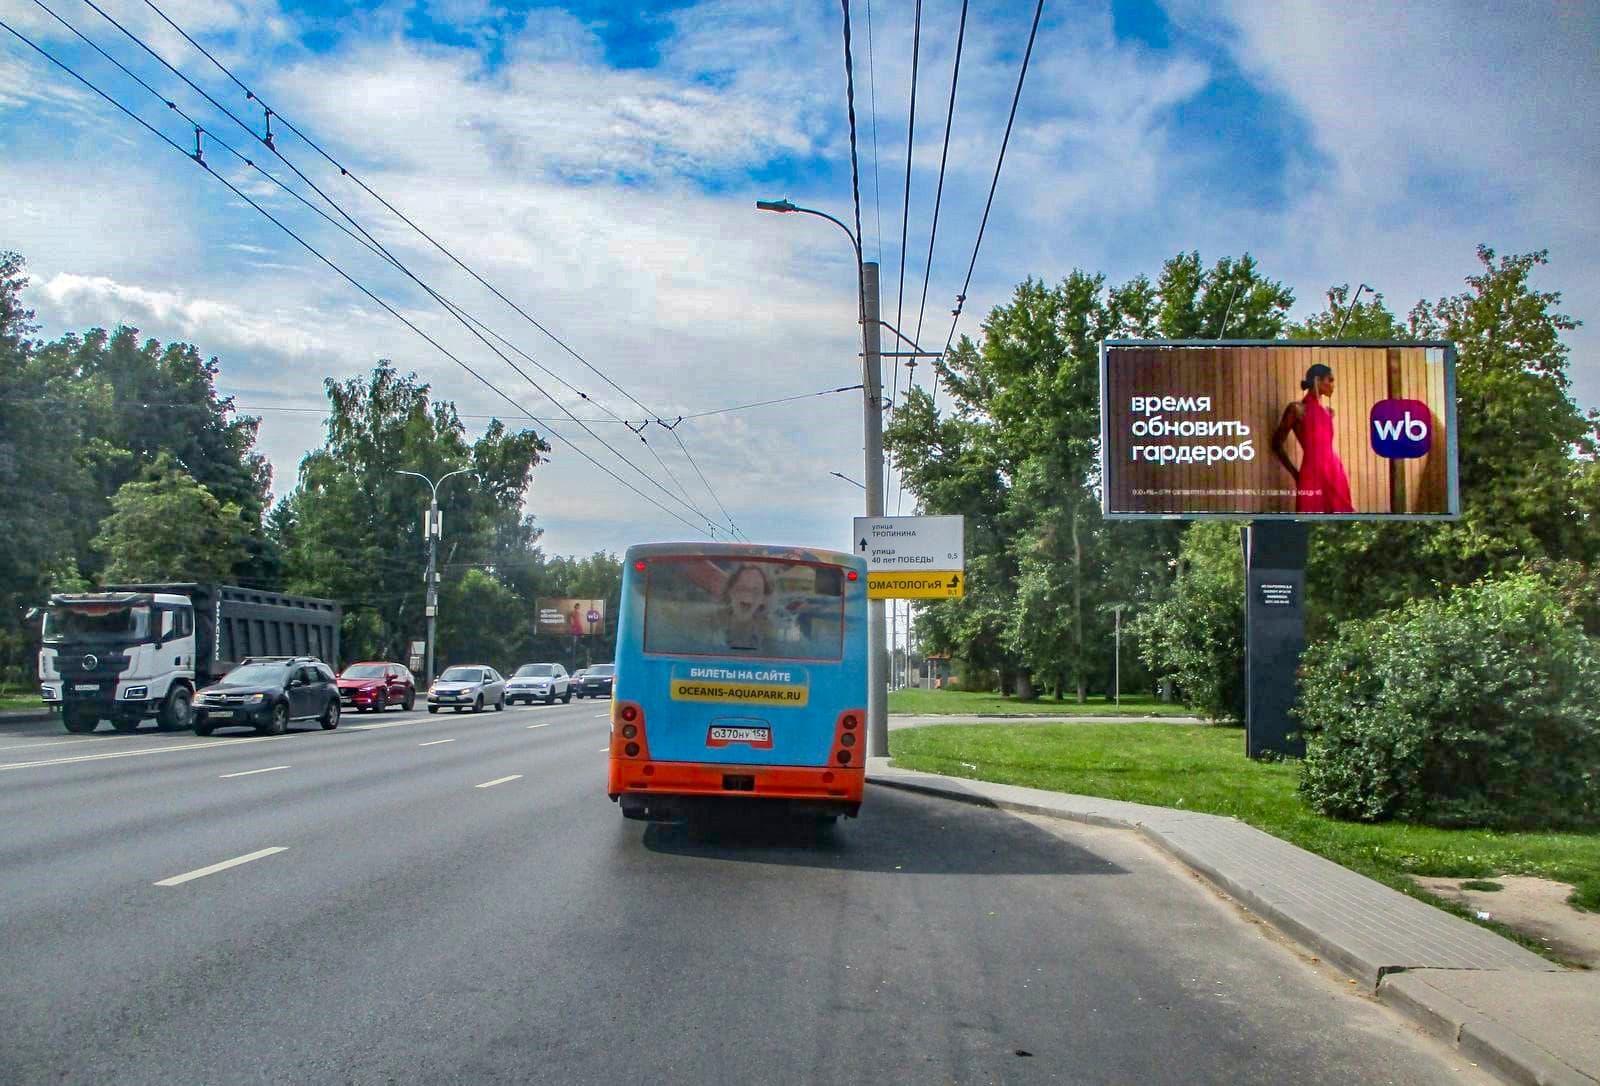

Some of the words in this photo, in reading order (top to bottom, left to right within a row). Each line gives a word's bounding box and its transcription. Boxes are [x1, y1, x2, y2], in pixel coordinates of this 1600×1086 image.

[1131, 396, 1211, 417] время
[1131, 415, 1250, 437] обновить
[1373, 411, 1428, 442] wb
[1132, 439, 1255, 466] гардероб
[872, 530, 917, 538] ТРОПИНИНА
[871, 556, 881, 564] 40
[897, 556, 934, 565] ПОБЕДЫ
[690, 667, 735, 679] БИЛЕТЫ
[738, 670, 754, 681] НА
[756, 669, 791, 682] САЙТЕ
[678, 686, 801, 700] OCEANIS-AQUAPARK.RU
